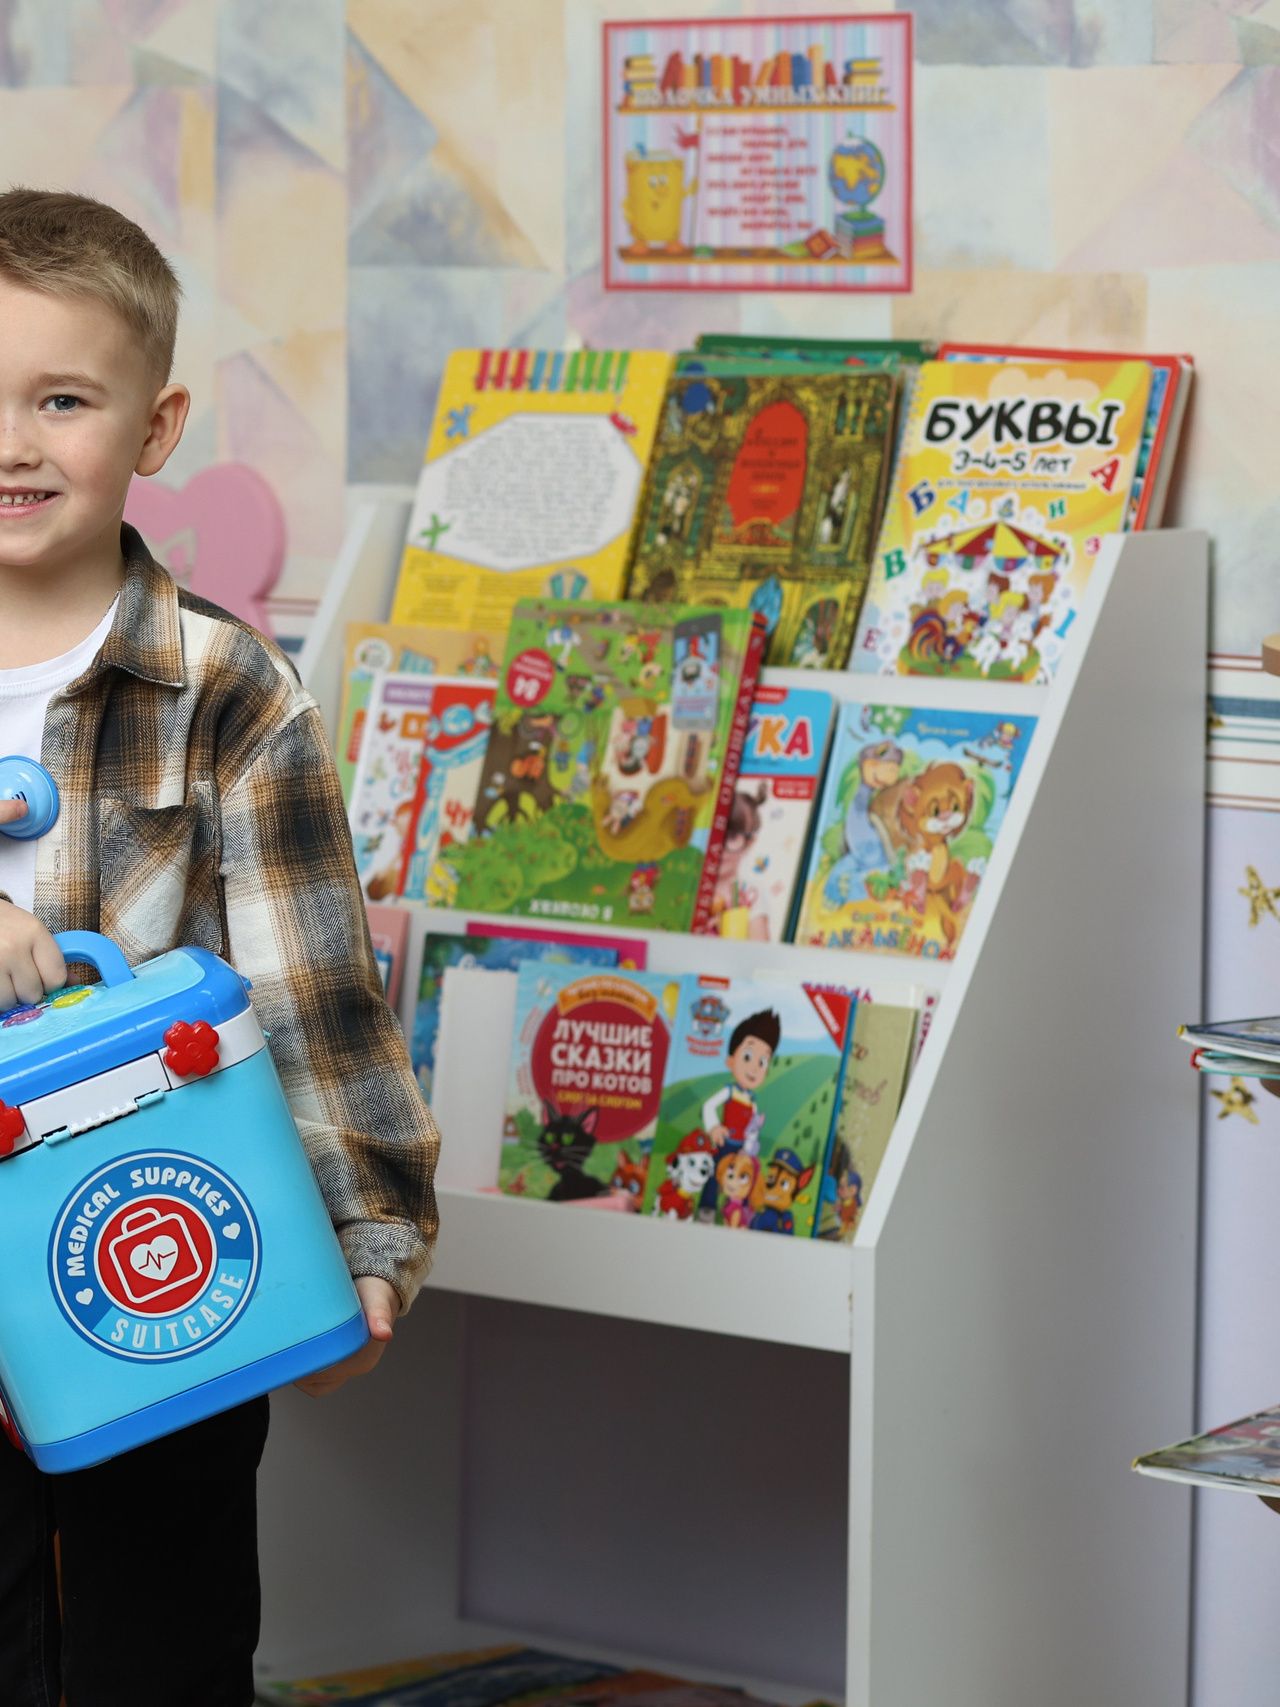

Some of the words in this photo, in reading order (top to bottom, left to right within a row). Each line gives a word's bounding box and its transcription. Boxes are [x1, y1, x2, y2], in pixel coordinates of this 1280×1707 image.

[924, 400, 1120, 444] БУКВЫ
[954, 450, 1026, 471] 3-4-5
[1033, 456, 1072, 472] лет
[721, 676, 756, 806] ОКОШКАХ
[552, 1018, 653, 1048] ЛУЧШИЕ
[550, 1042, 653, 1075] СКАЗКИ
[551, 1068, 589, 1089] ПРО
[592, 1072, 652, 1095] КОТОВ
[67, 1183, 120, 1276] MEDICAL
[130, 1167, 231, 1216] SUPPLIES
[111, 1273, 244, 1349] SUITCASE
